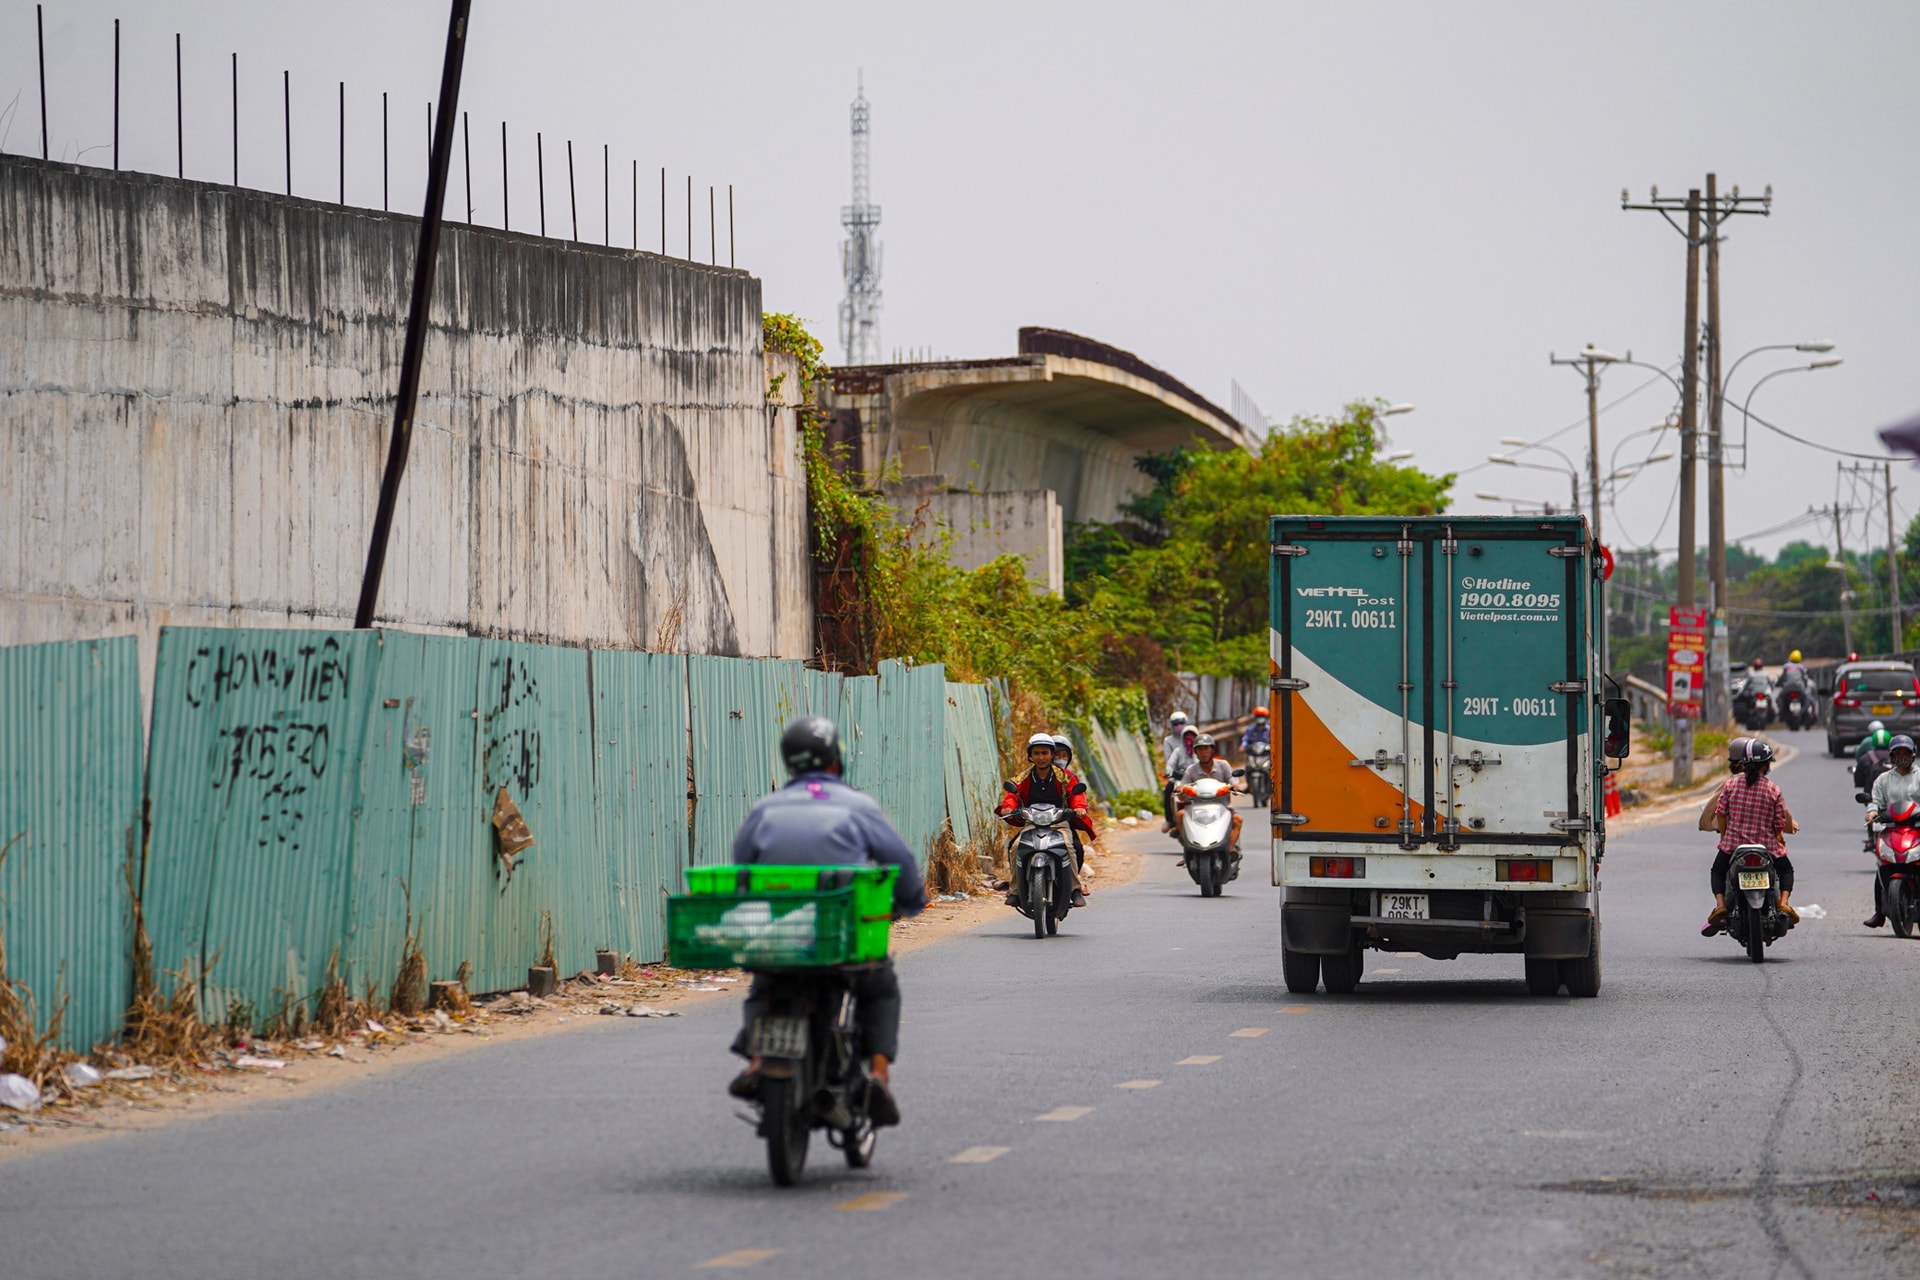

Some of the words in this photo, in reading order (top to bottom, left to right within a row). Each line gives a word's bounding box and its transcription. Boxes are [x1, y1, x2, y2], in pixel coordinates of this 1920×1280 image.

[1475, 578, 1531, 590] Hotline
[1296, 586, 1369, 597] VIETTEL
[1357, 597, 1395, 606] post
[1460, 592, 1560, 608] 1900.8095
[1305, 609, 1347, 628] 29KT.
[1351, 610, 1396, 629] 00611
[1460, 611, 1558, 623] Viettelpost.com.vn
[1463, 697, 1499, 716] 29KT
[1512, 698, 1557, 716] 00611
[1391, 896, 1419, 910] 29KT
